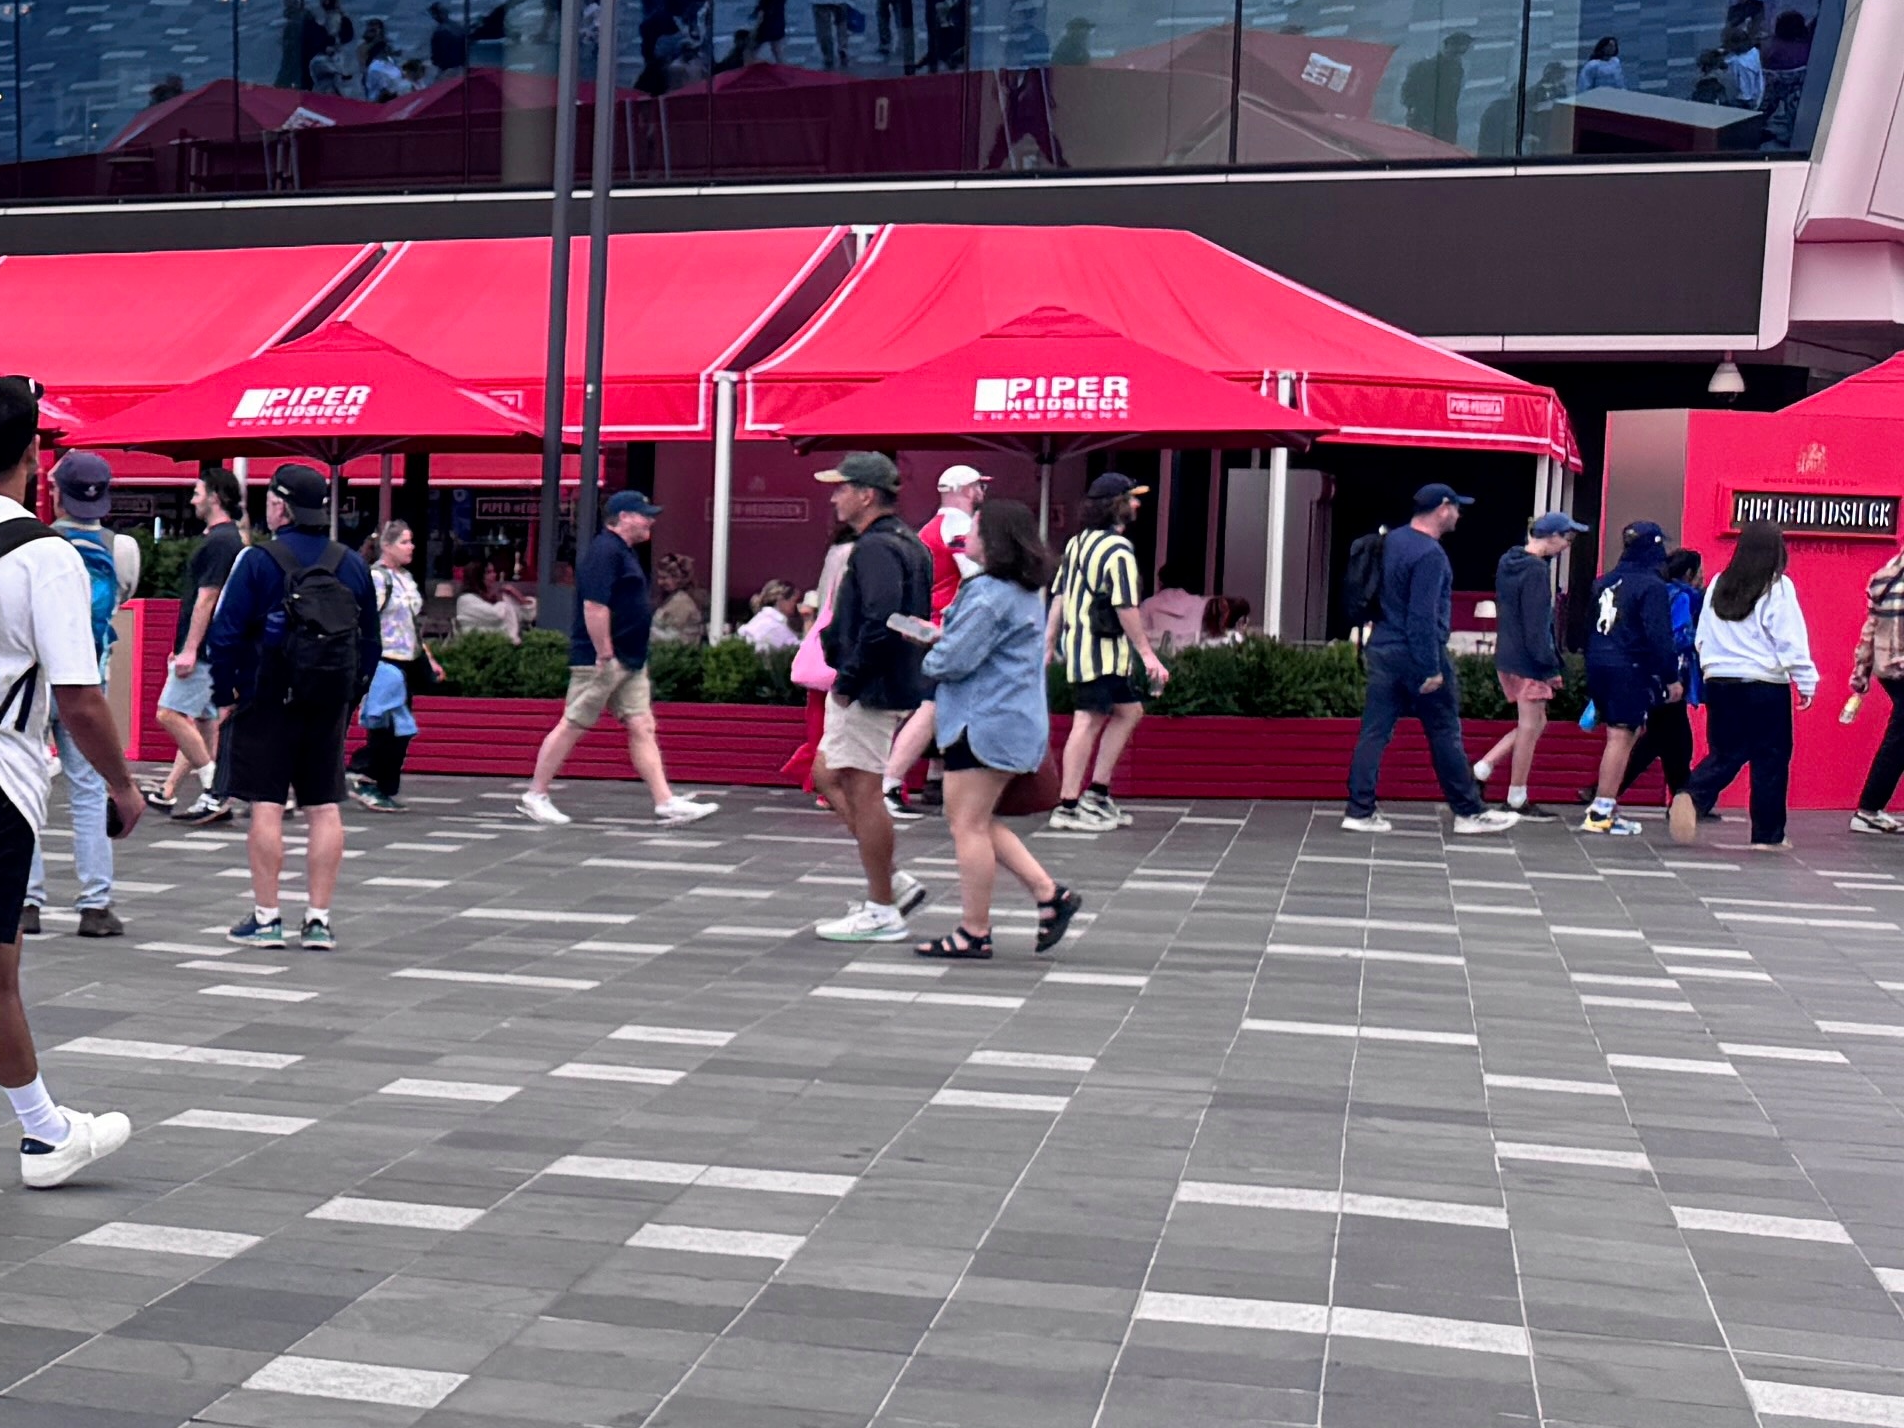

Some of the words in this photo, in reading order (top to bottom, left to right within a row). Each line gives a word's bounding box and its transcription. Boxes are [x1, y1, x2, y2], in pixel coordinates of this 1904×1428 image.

[265, 385, 371, 406] PIPER
[1008, 376, 1129, 398] PIPER
[259, 405, 363, 418] HEIDSIECK
[1007, 397, 1129, 411] HEIDSIECK
